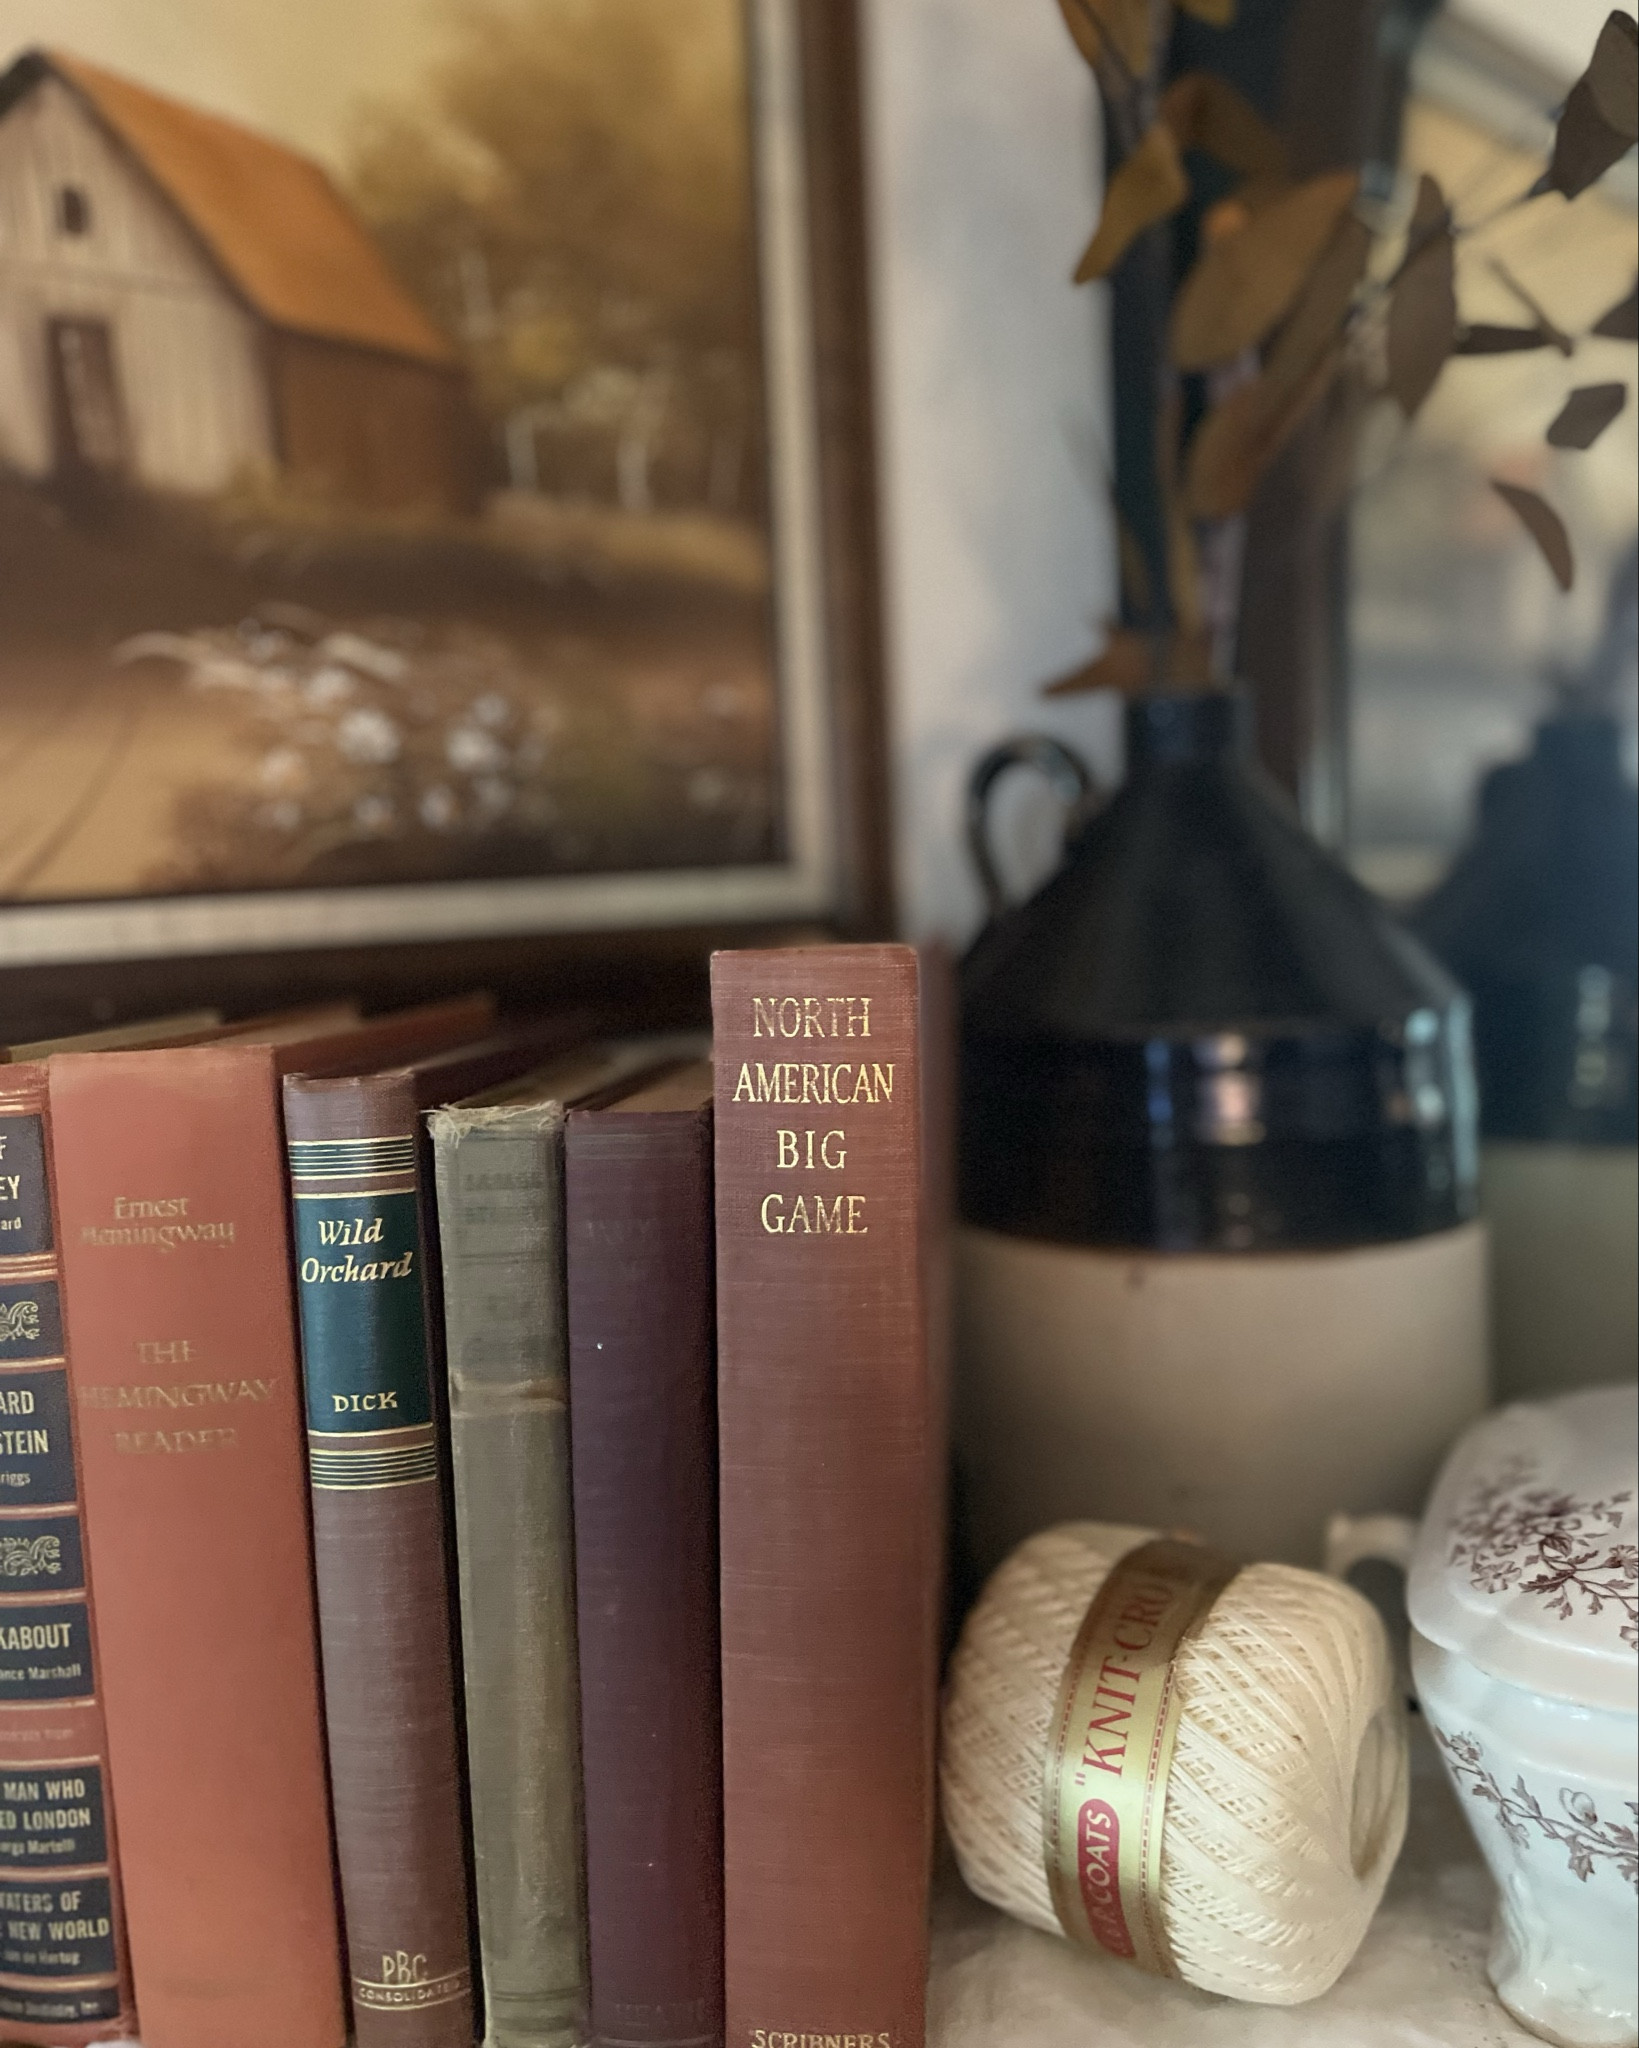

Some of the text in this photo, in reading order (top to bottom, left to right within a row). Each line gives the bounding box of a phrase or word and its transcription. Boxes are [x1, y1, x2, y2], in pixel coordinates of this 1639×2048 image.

[752, 998, 873, 1038] NORTH
[732, 1062, 897, 1105] AMERICAN
[776, 1129, 848, 1170] BIG
[115, 1196, 190, 1220] Ernest
[761, 1193, 869, 1235] GAME
[318, 1217, 385, 1246] Wild
[301, 1251, 414, 1284] Orchard
[331, 1391, 398, 1413] DICK
[3, 1778, 86, 1801] MAN WHO
[23, 1808, 91, 1831] LONDON
[60, 1890, 81, 1912] OF
[8, 1918, 110, 1941] NEW WORLD
